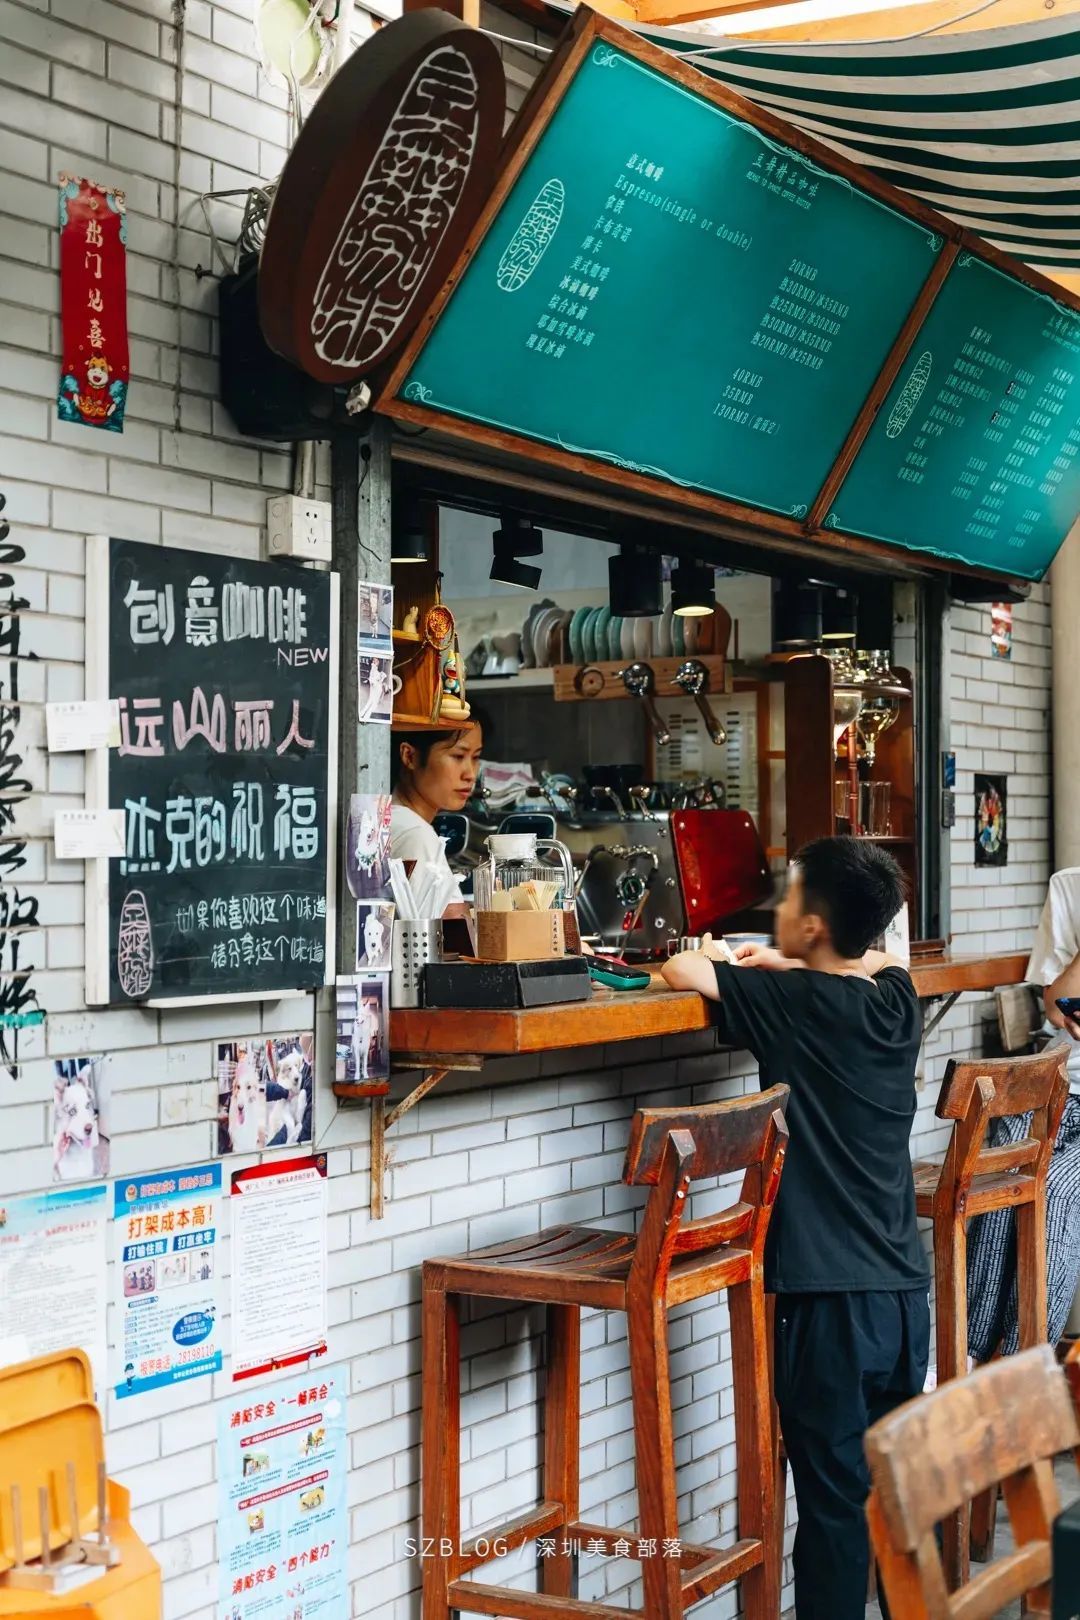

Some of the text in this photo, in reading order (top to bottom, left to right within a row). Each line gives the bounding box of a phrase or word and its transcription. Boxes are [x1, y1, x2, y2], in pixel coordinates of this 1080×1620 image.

[626, 154, 664, 181] 意式咖啡
[594, 215, 633, 243] 卡布奇诺
[700, 218, 713, 231] or
[716, 223, 753, 252] double)
[84, 218, 106, 349] 出门见喜
[570, 255, 611, 282] 美式咖啡
[788, 258, 818, 281] 20RMB
[123, 575, 308, 647] 创意咖啡
[276, 647, 328, 669] NEW
[118, 686, 315, 757] 远山丽人
[120, 781, 319, 876] 杰克的祝福
